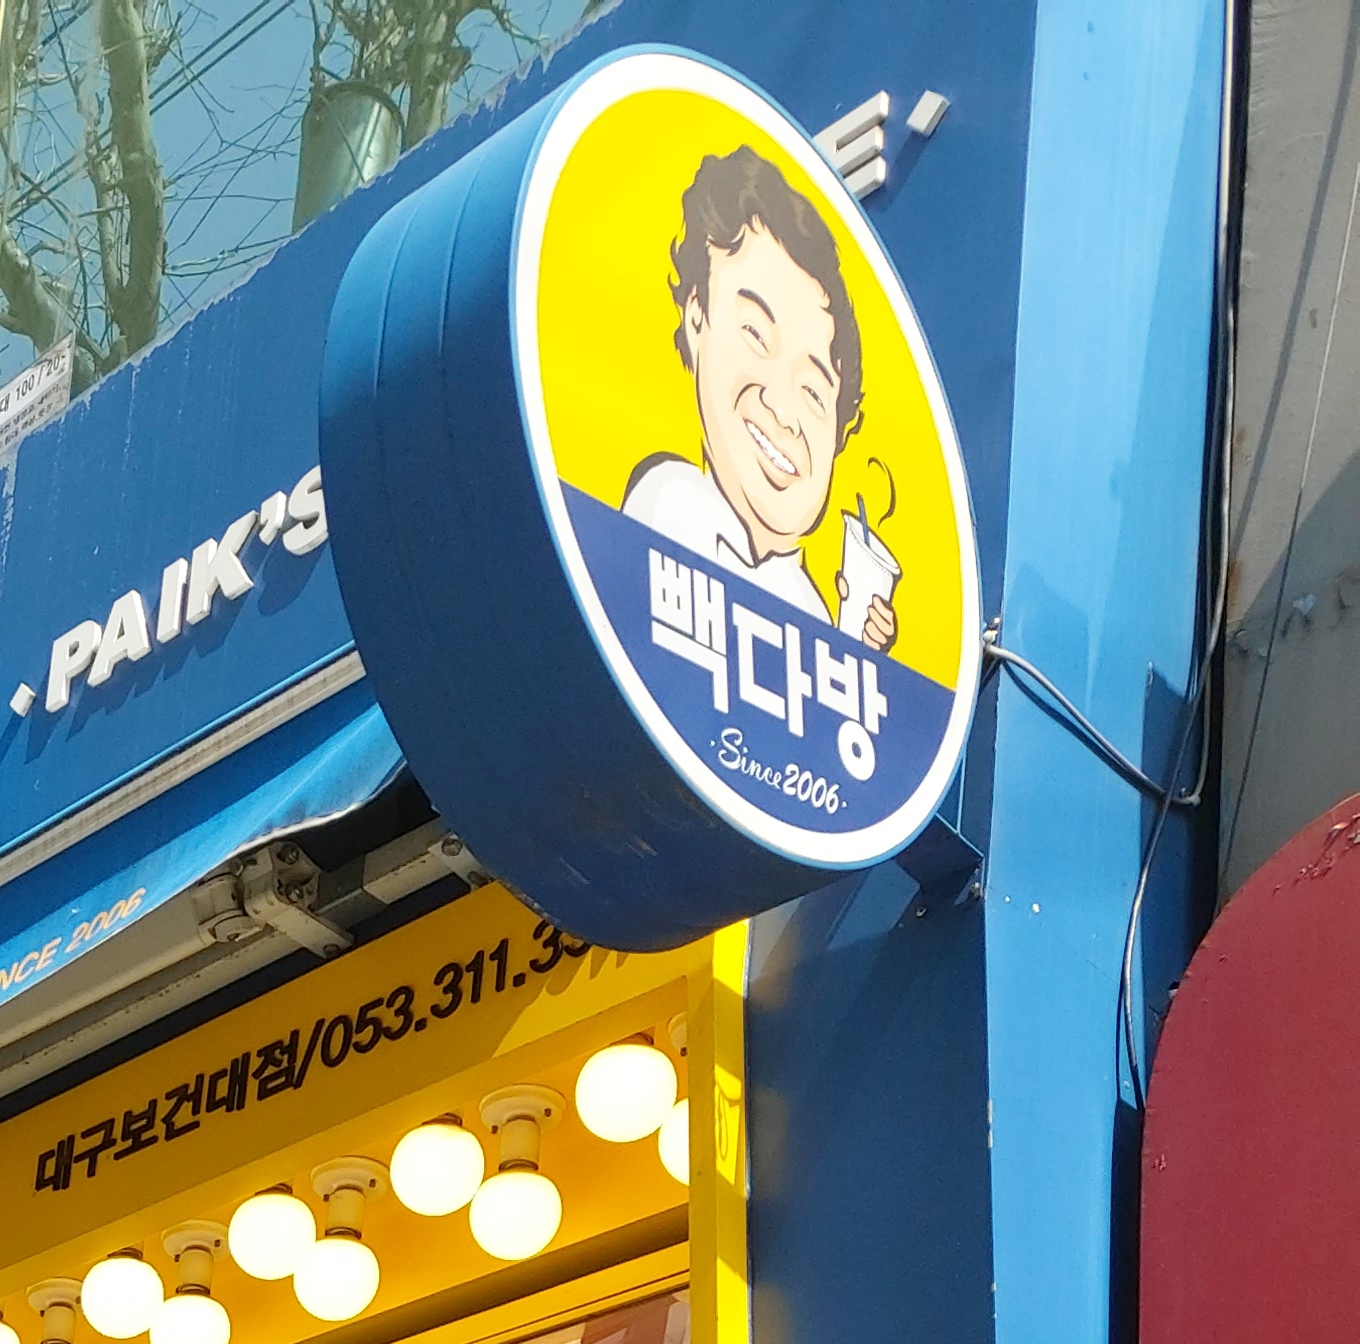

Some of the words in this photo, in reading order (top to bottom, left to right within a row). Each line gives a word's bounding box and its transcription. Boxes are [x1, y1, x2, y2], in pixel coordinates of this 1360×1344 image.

[44, 466, 332, 714] PAIK'S
[649, 546, 888, 781] 빽다방
[782, 763, 840, 814] 2006
[63, 888, 148, 957] 2006
[34, 918, 593, 1194] 대구보건대점/053.311.3
